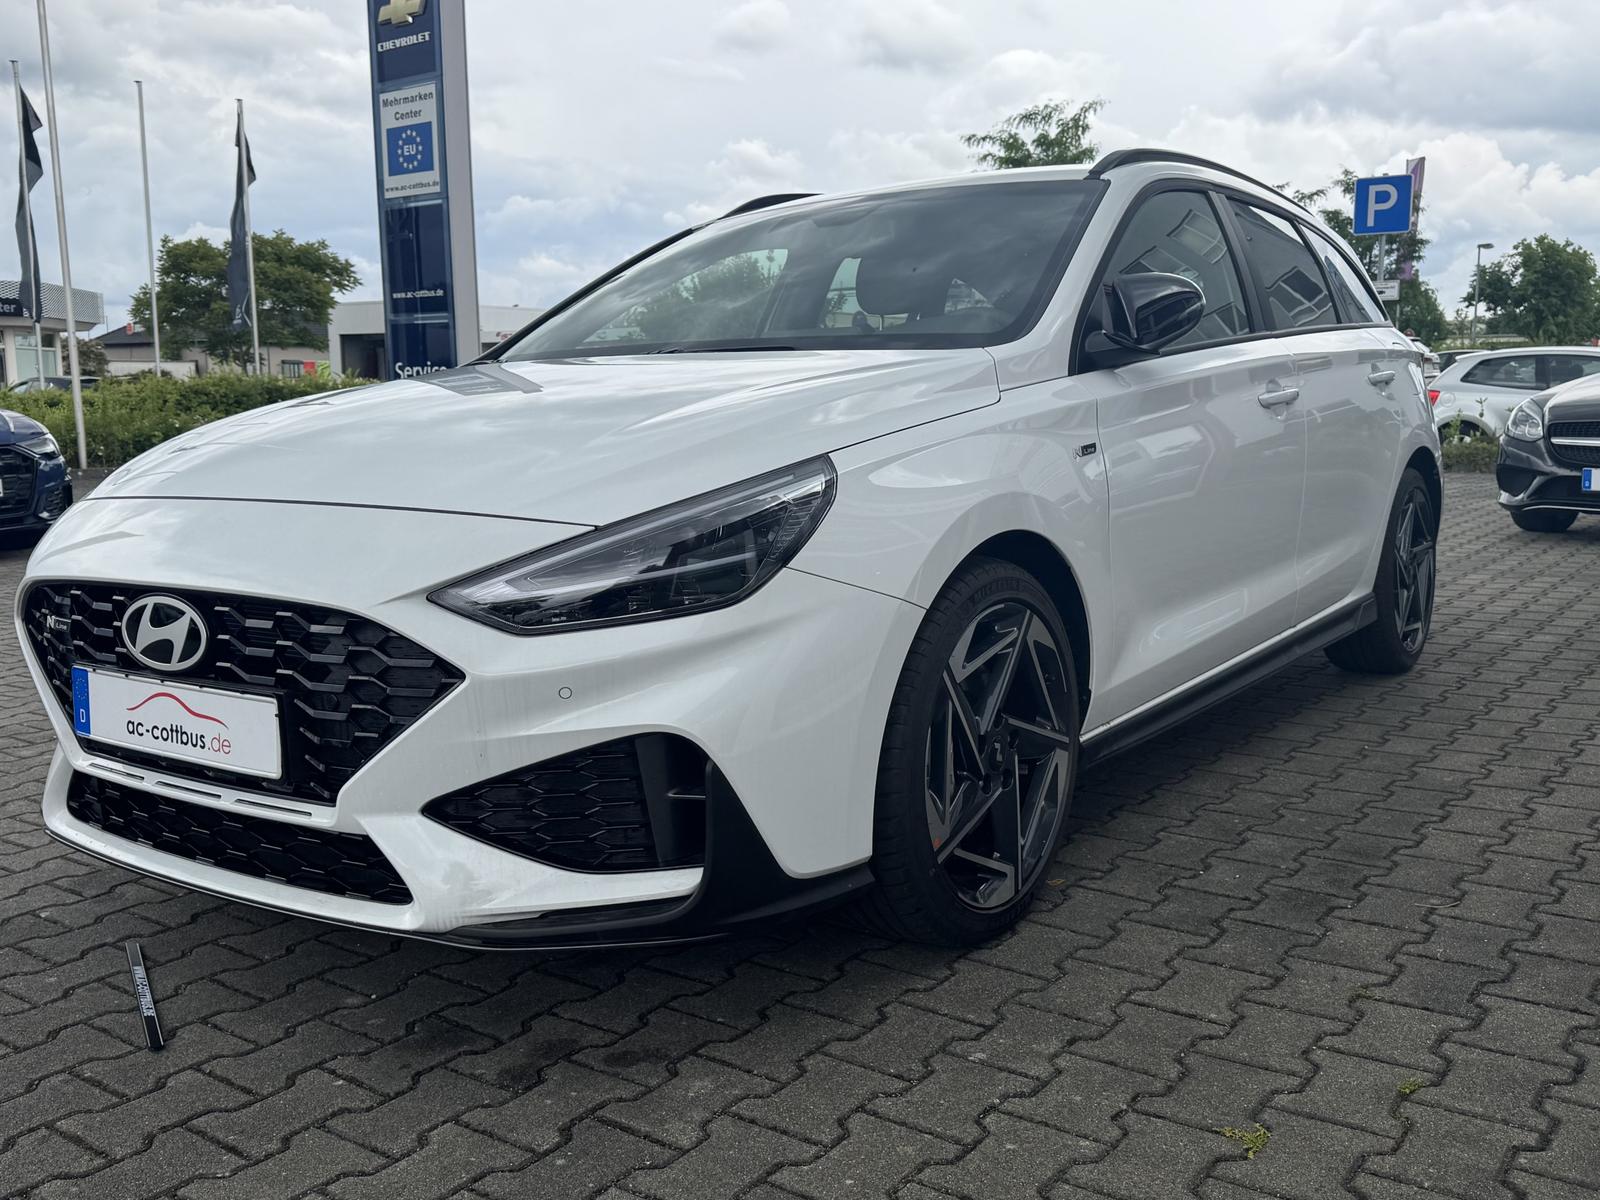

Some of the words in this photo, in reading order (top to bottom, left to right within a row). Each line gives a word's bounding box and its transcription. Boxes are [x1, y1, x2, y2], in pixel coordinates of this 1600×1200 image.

[377, 31, 431, 52] CHEVROLET
[382, 91, 434, 108] Mehrmarken
[394, 109, 422, 121] Center
[403, 144, 417, 156] EU
[385, 180, 439, 193] www.ac-cottbus.de
[1366, 183, 1398, 227] P
[79, 708, 86, 723] D
[126, 719, 232, 755] ac-cottbus.de
